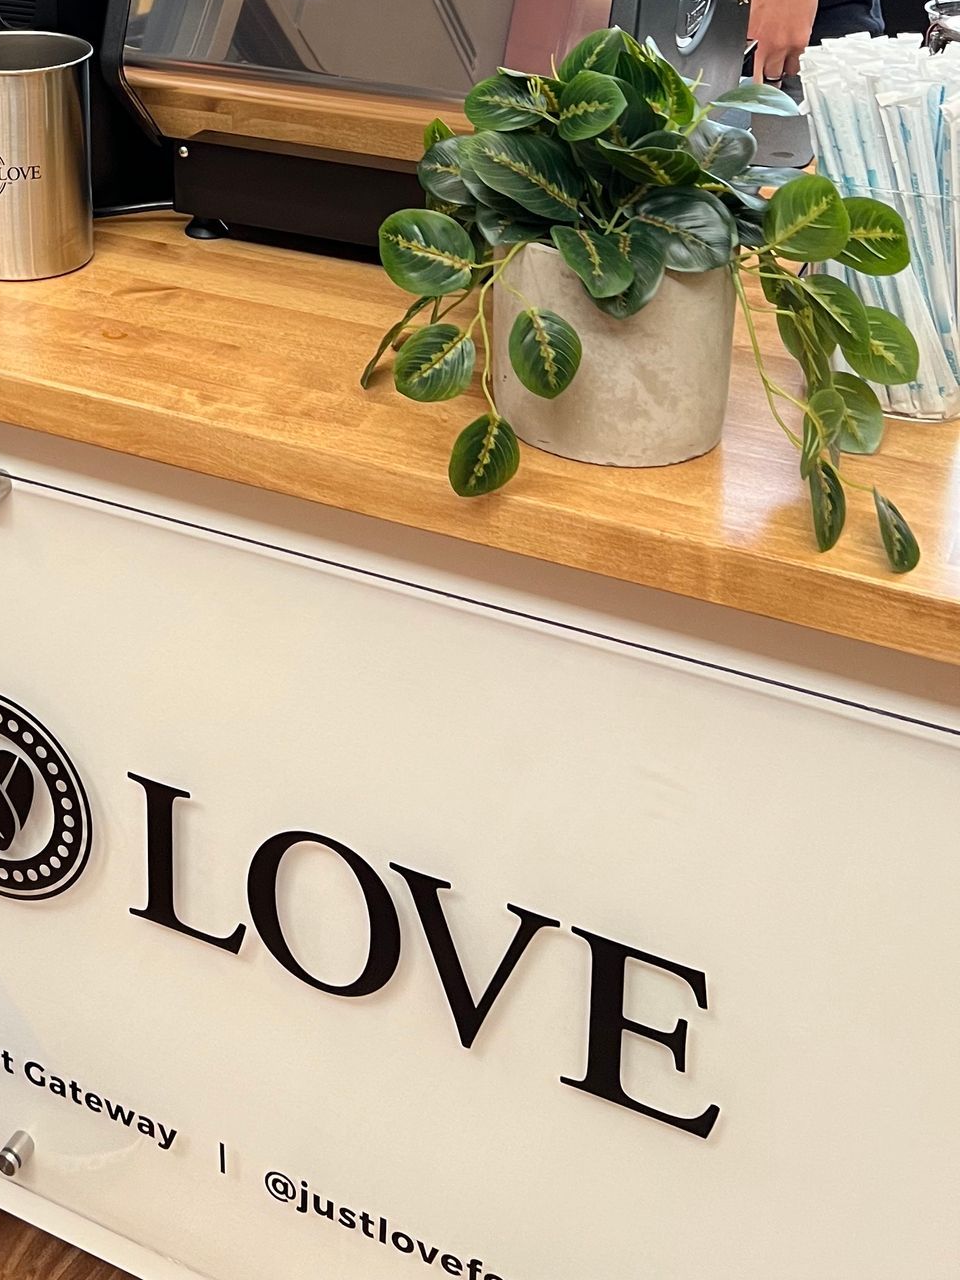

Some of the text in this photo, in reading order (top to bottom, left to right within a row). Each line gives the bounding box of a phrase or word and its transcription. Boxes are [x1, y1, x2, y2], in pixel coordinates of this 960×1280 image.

[126, 771, 721, 1140] LOVE
[24, 1061, 177, 1150] Gateway
[264, 1171, 504, 1280] @justlovef
